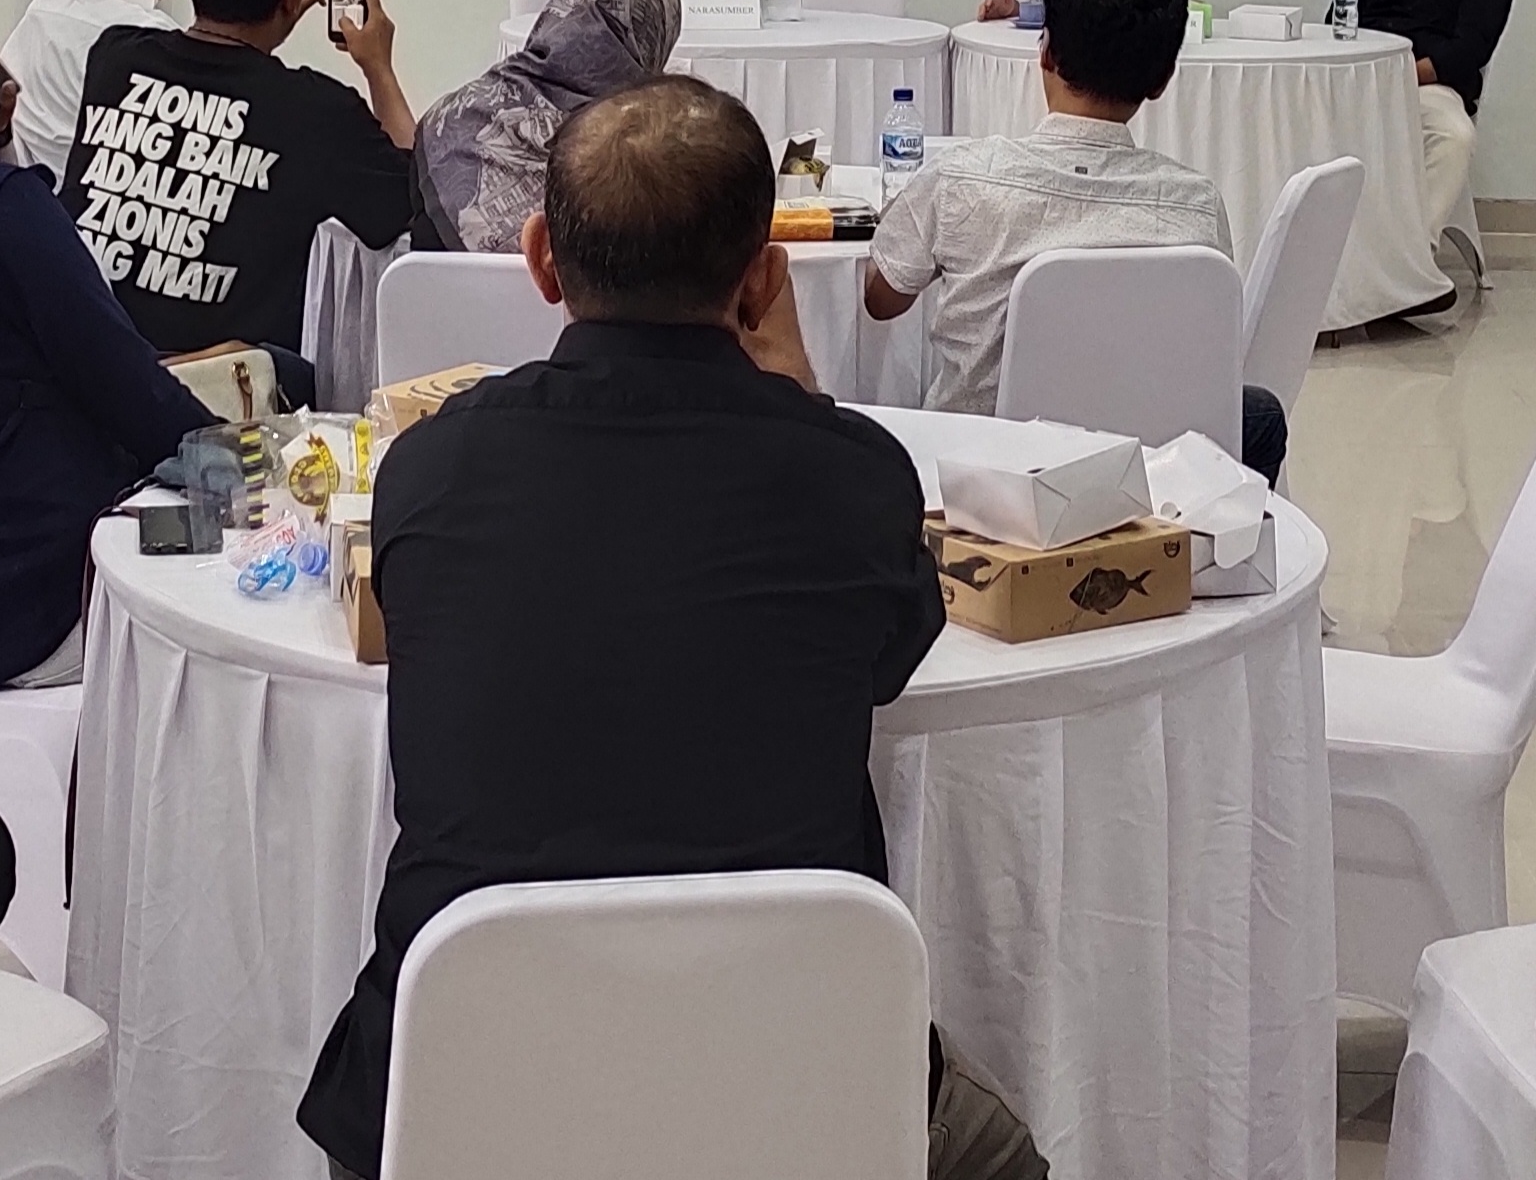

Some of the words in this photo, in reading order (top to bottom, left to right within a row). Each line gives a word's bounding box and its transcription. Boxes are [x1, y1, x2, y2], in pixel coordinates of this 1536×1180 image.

[688, 6, 754, 14] NARASUMBER
[118, 72, 250, 140] ZIONIS
[81, 105, 175, 162] YANG
[175, 130, 280, 191] BAIK
[80, 148, 237, 223] ADALAH
[76, 187, 211, 259] ZIONIS
[135, 250, 239, 304] MATI
